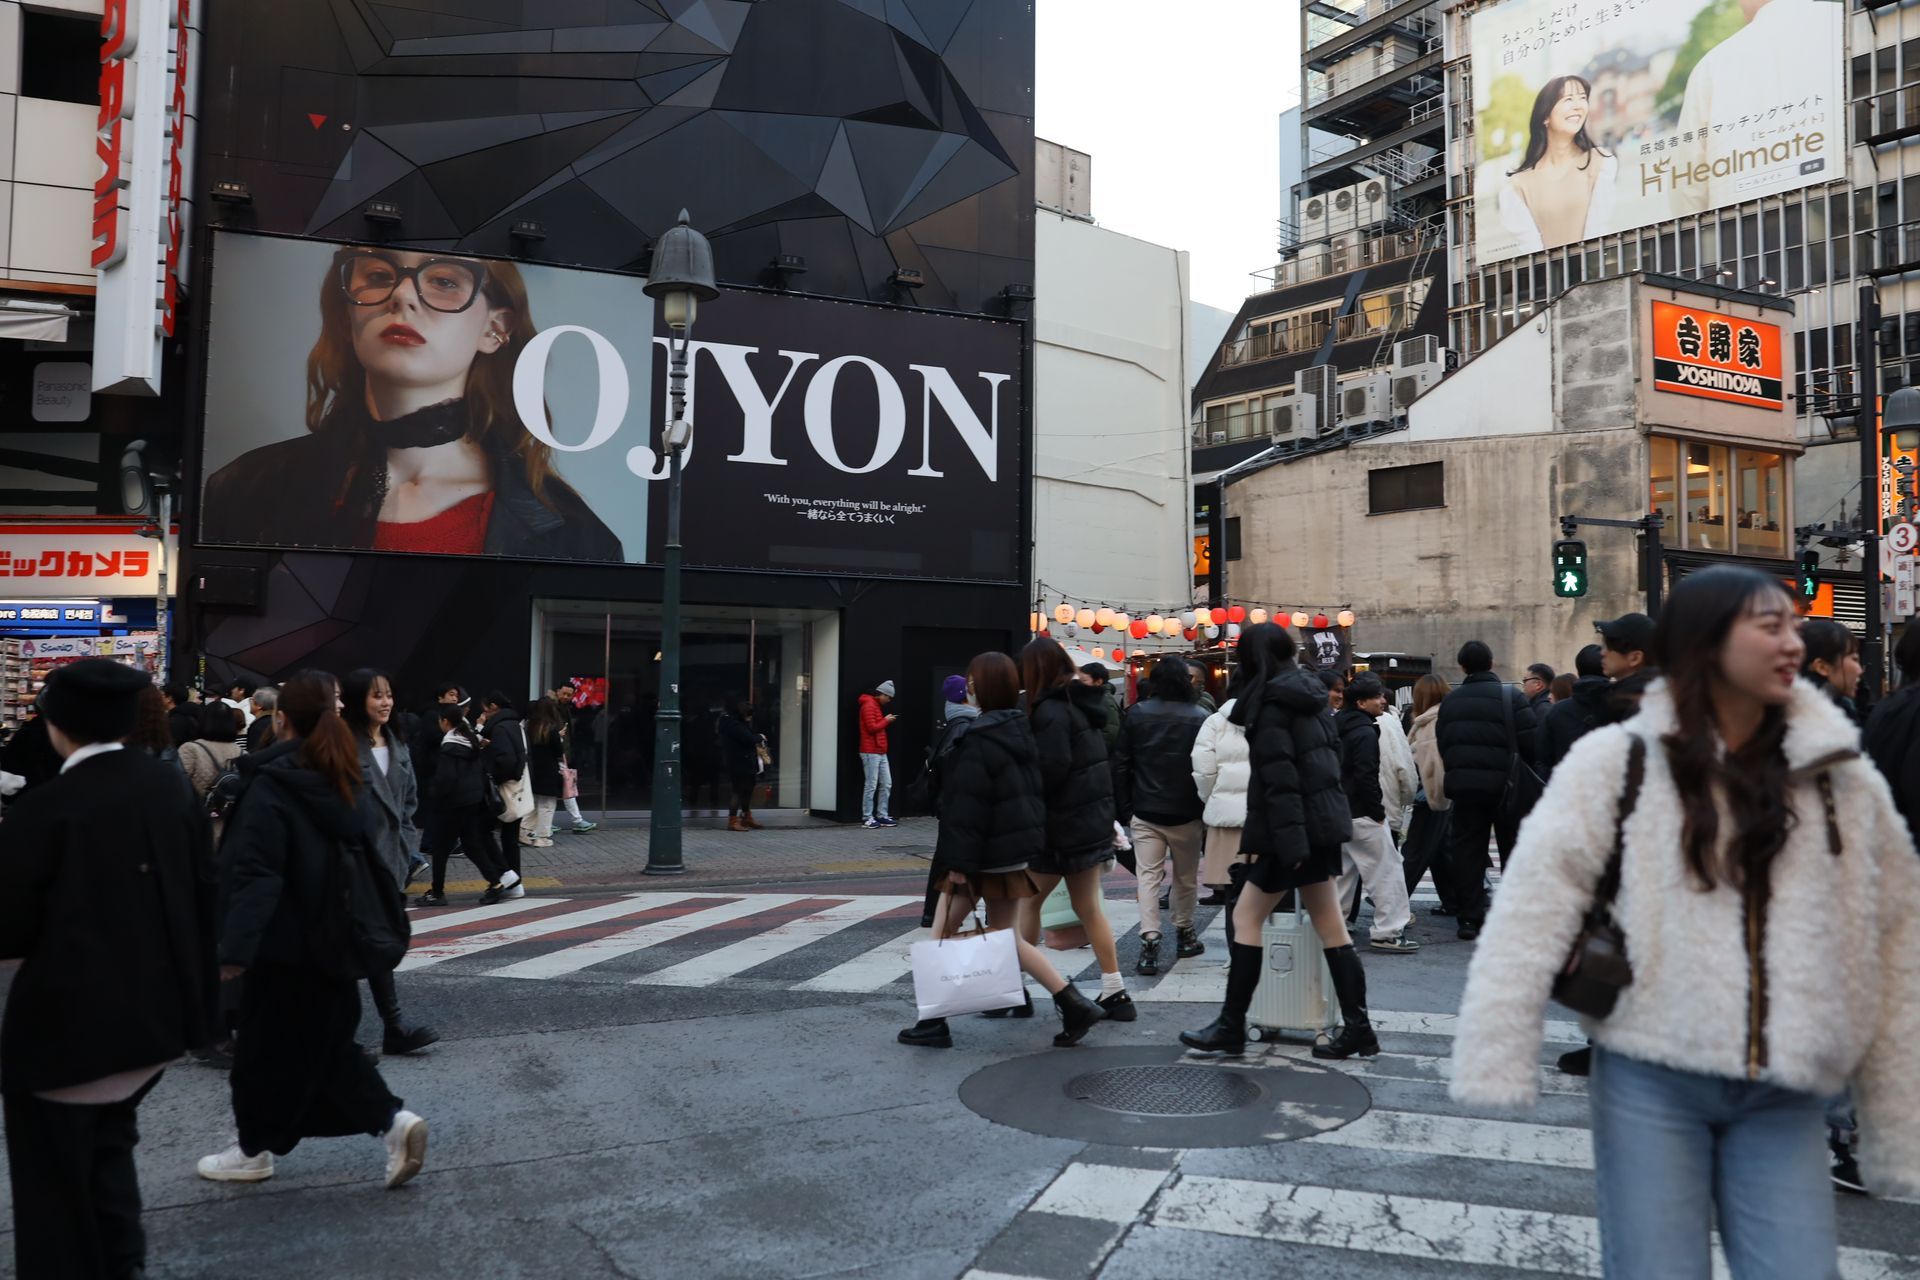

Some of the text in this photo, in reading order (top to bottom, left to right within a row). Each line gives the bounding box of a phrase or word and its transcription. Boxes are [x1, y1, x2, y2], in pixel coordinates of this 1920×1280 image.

[1501, 3, 1577, 46] ちょっとだけ
[1640, 94, 1823, 156] 既婚者専用マッチングサイト
[1672, 132, 1825, 189] Healmate
[38, 381, 88, 392] Panasonic
[1677, 364, 1762, 395] YOSHINOYA
[37, 394, 72, 408] Beauty
[512, 324, 1011, 481] OJYON
[791, 497, 812, 506] you,
[812, 498, 860, 510] everything
[861, 500, 879, 510] will
[880, 501, 891, 511] be
[796, 508, 896, 524] 一緒なら全てうまくいく
[1896, 527, 1910, 547] 3
[40, 643, 74, 652] Sanrio
